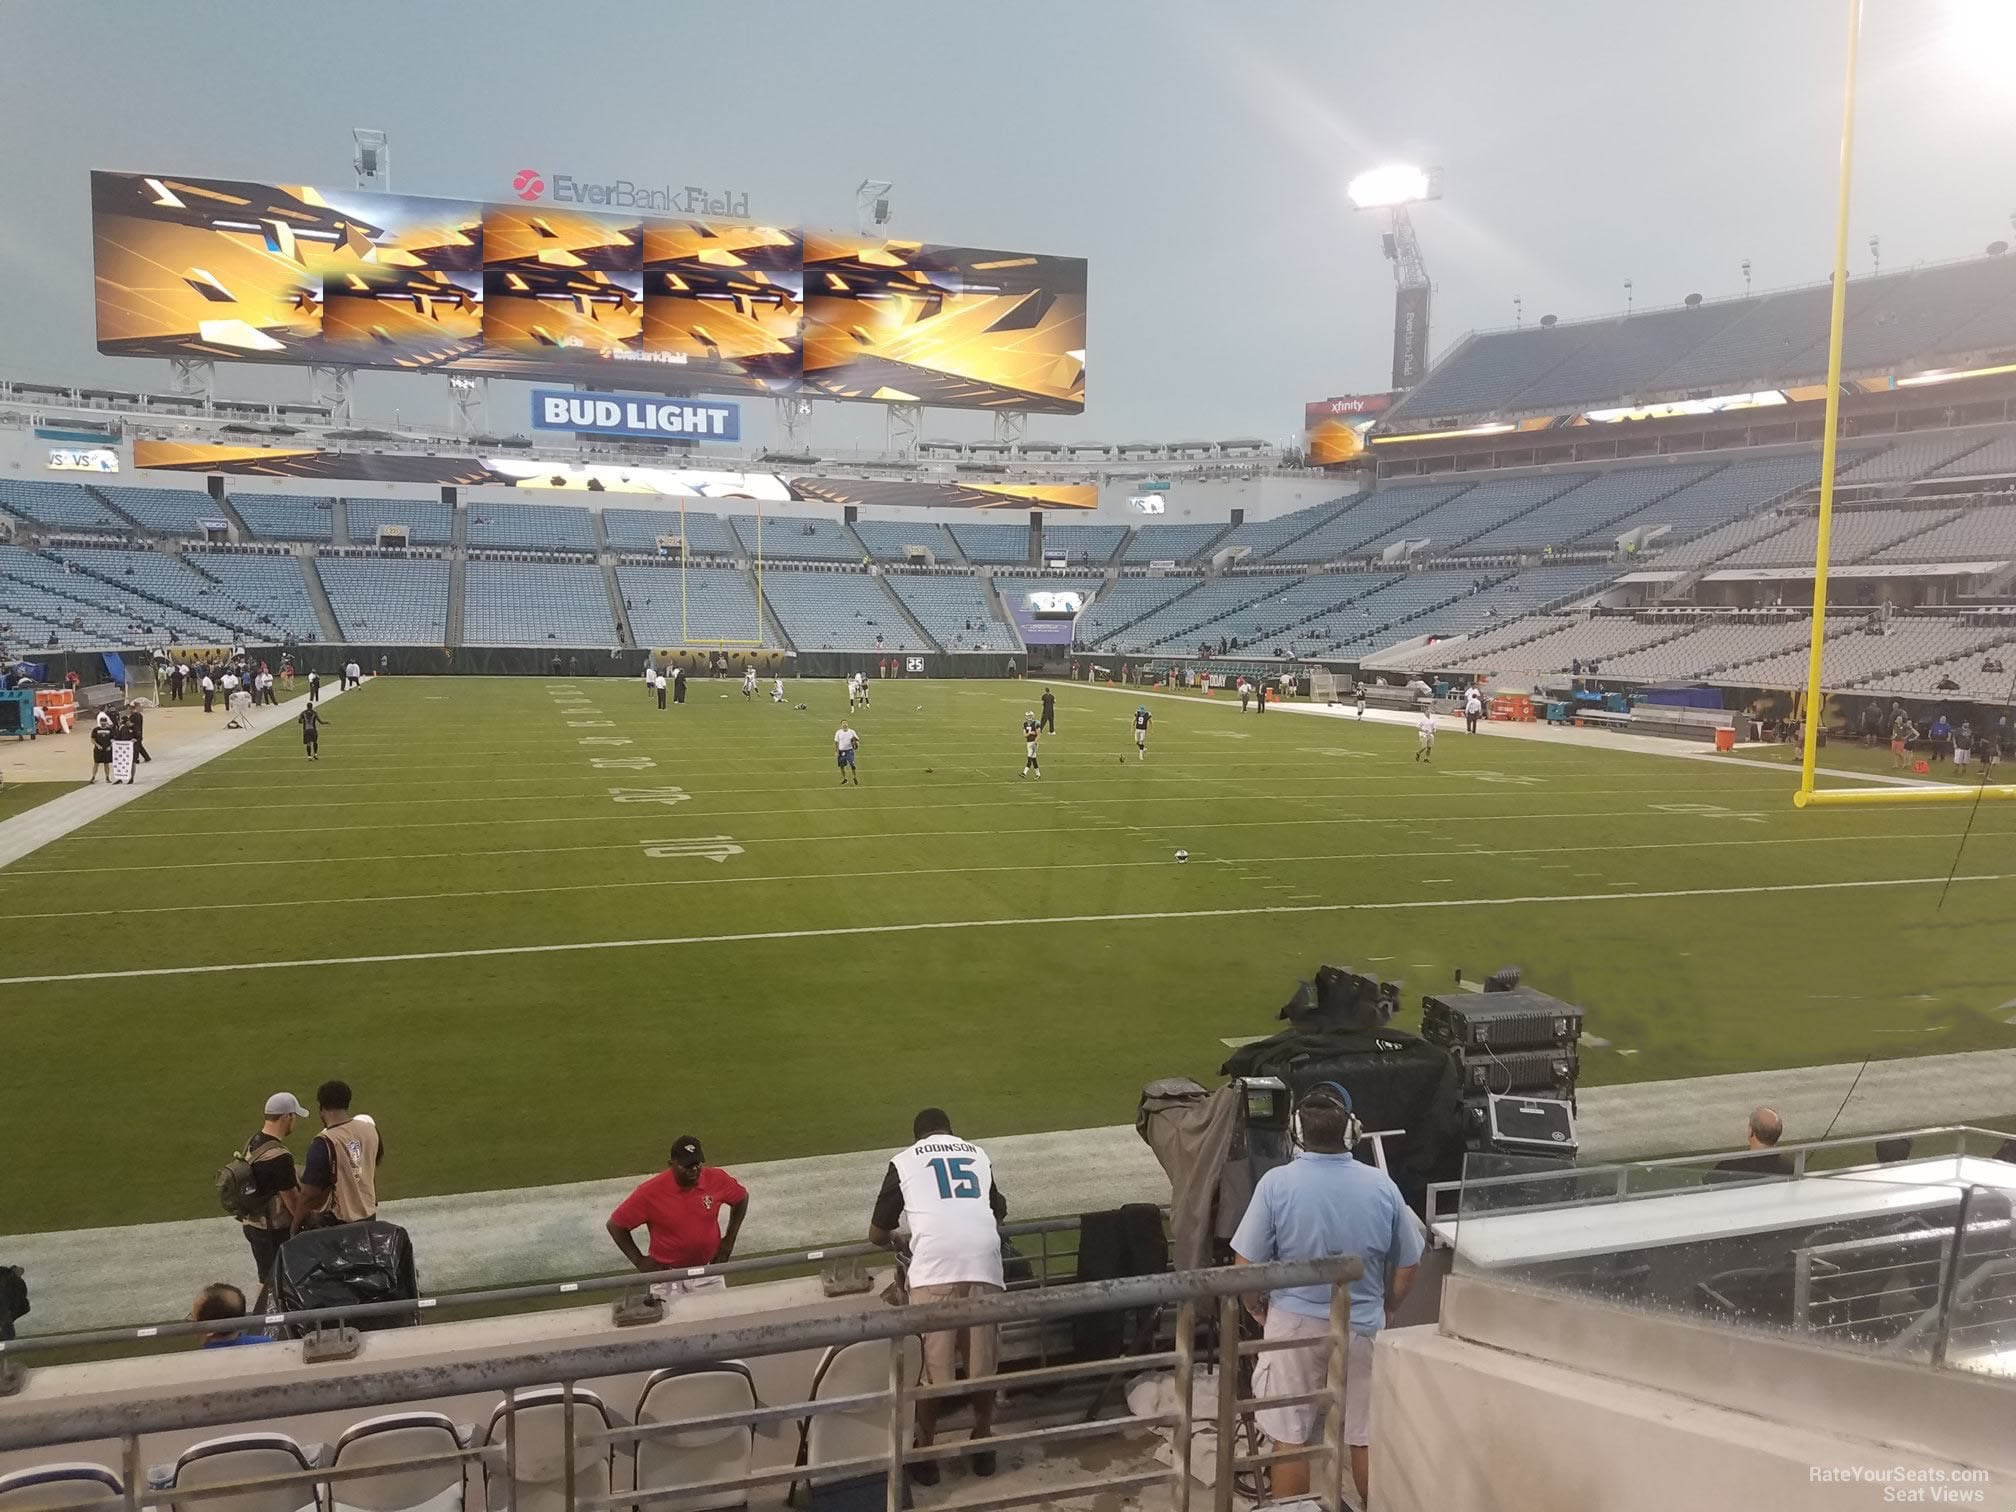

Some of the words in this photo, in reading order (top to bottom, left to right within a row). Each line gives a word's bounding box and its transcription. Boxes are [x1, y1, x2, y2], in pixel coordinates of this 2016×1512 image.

[552, 174, 682, 212] EverBank
[684, 186, 750, 218] Field
[544, 397, 622, 427] BUD
[627, 403, 729, 434] LIGHT
[1331, 400, 1365, 413] xfinity
[908, 659, 922, 670] 25
[915, 1143, 978, 1156] ROBINSON
[926, 1157, 982, 1200] 15
